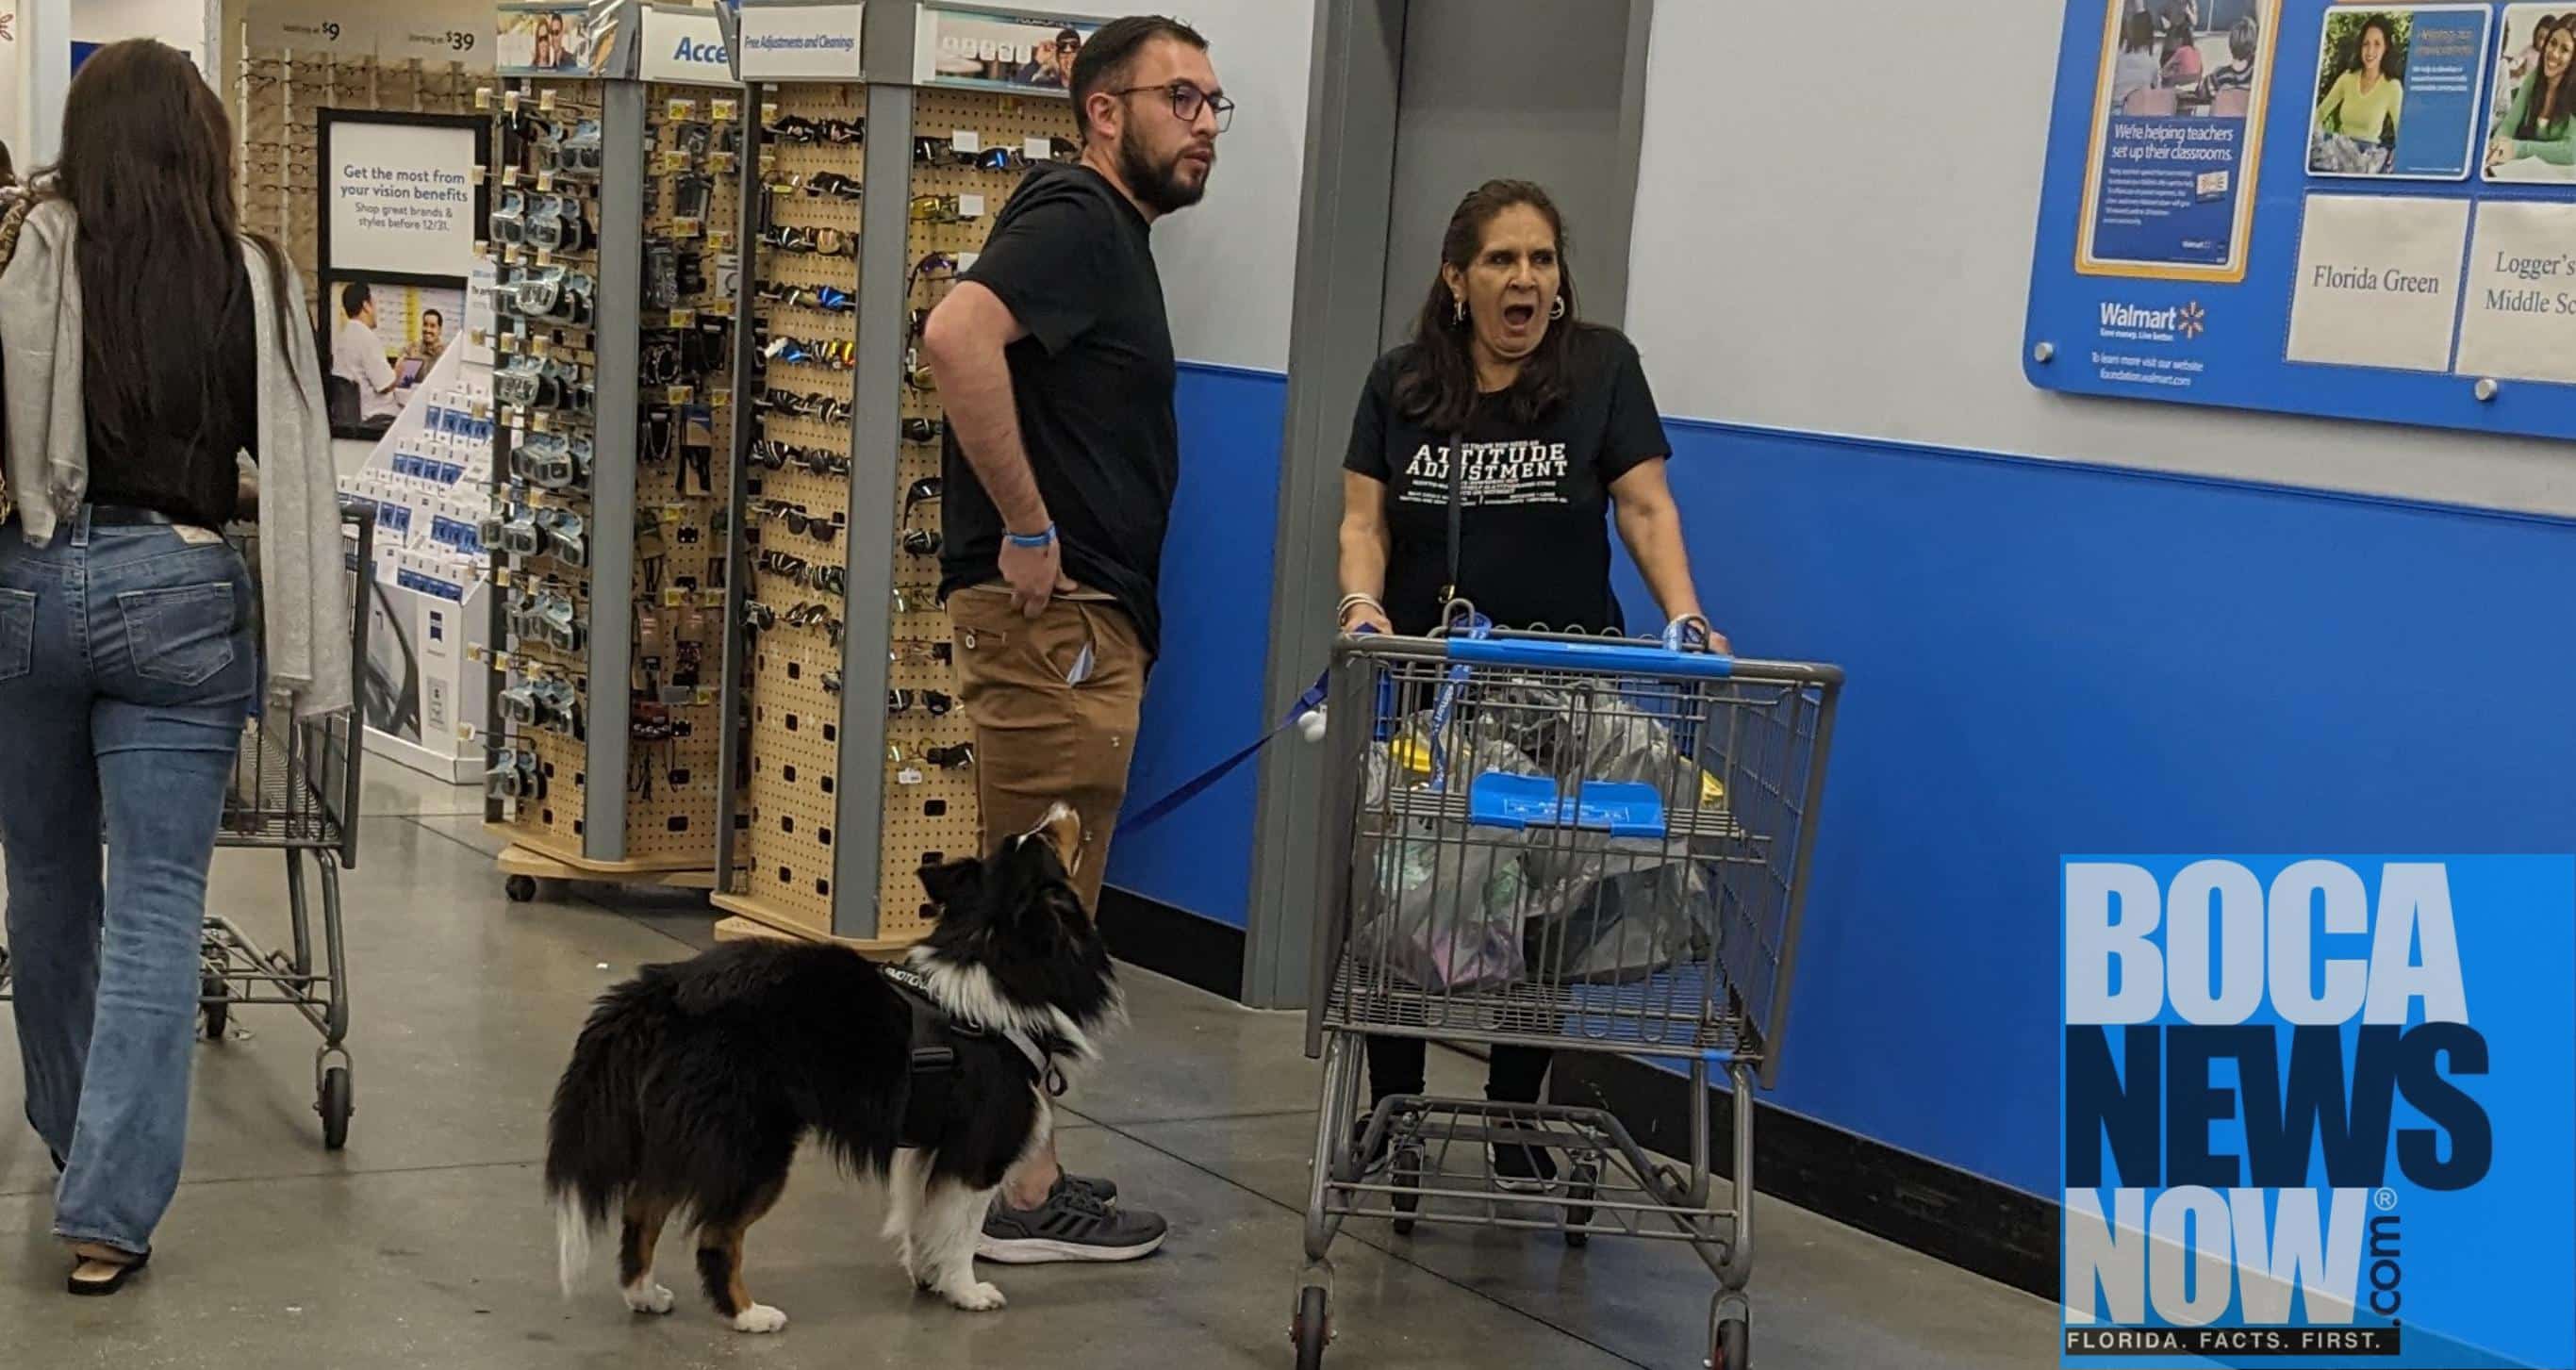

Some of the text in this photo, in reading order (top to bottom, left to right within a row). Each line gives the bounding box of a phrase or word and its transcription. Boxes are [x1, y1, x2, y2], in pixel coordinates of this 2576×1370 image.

[322, 23, 340, 41] $9
[446, 31, 474, 51] $39
[745, 34, 854, 52] Free Adjustments and Cleanings
[2144, 124, 2186, 142] helping
[2188, 125, 2234, 140] teachers
[2112, 144, 2233, 161] set up their classrooms.
[343, 164, 465, 184] Get the most from
[340, 184, 468, 202] your vision benefits
[355, 202, 379, 214] Shop
[382, 206, 407, 216] great
[410, 206, 443, 217] brands
[358, 218, 386, 228] styles
[388, 219, 421, 229] before
[2495, 251, 2575, 280] Logger's
[2312, 265, 2439, 293] Florida Green
[2485, 289, 2551, 313] Middle
[2100, 302, 2176, 330] Walmart
[1406, 460, 1568, 480] ADJSTMENT
